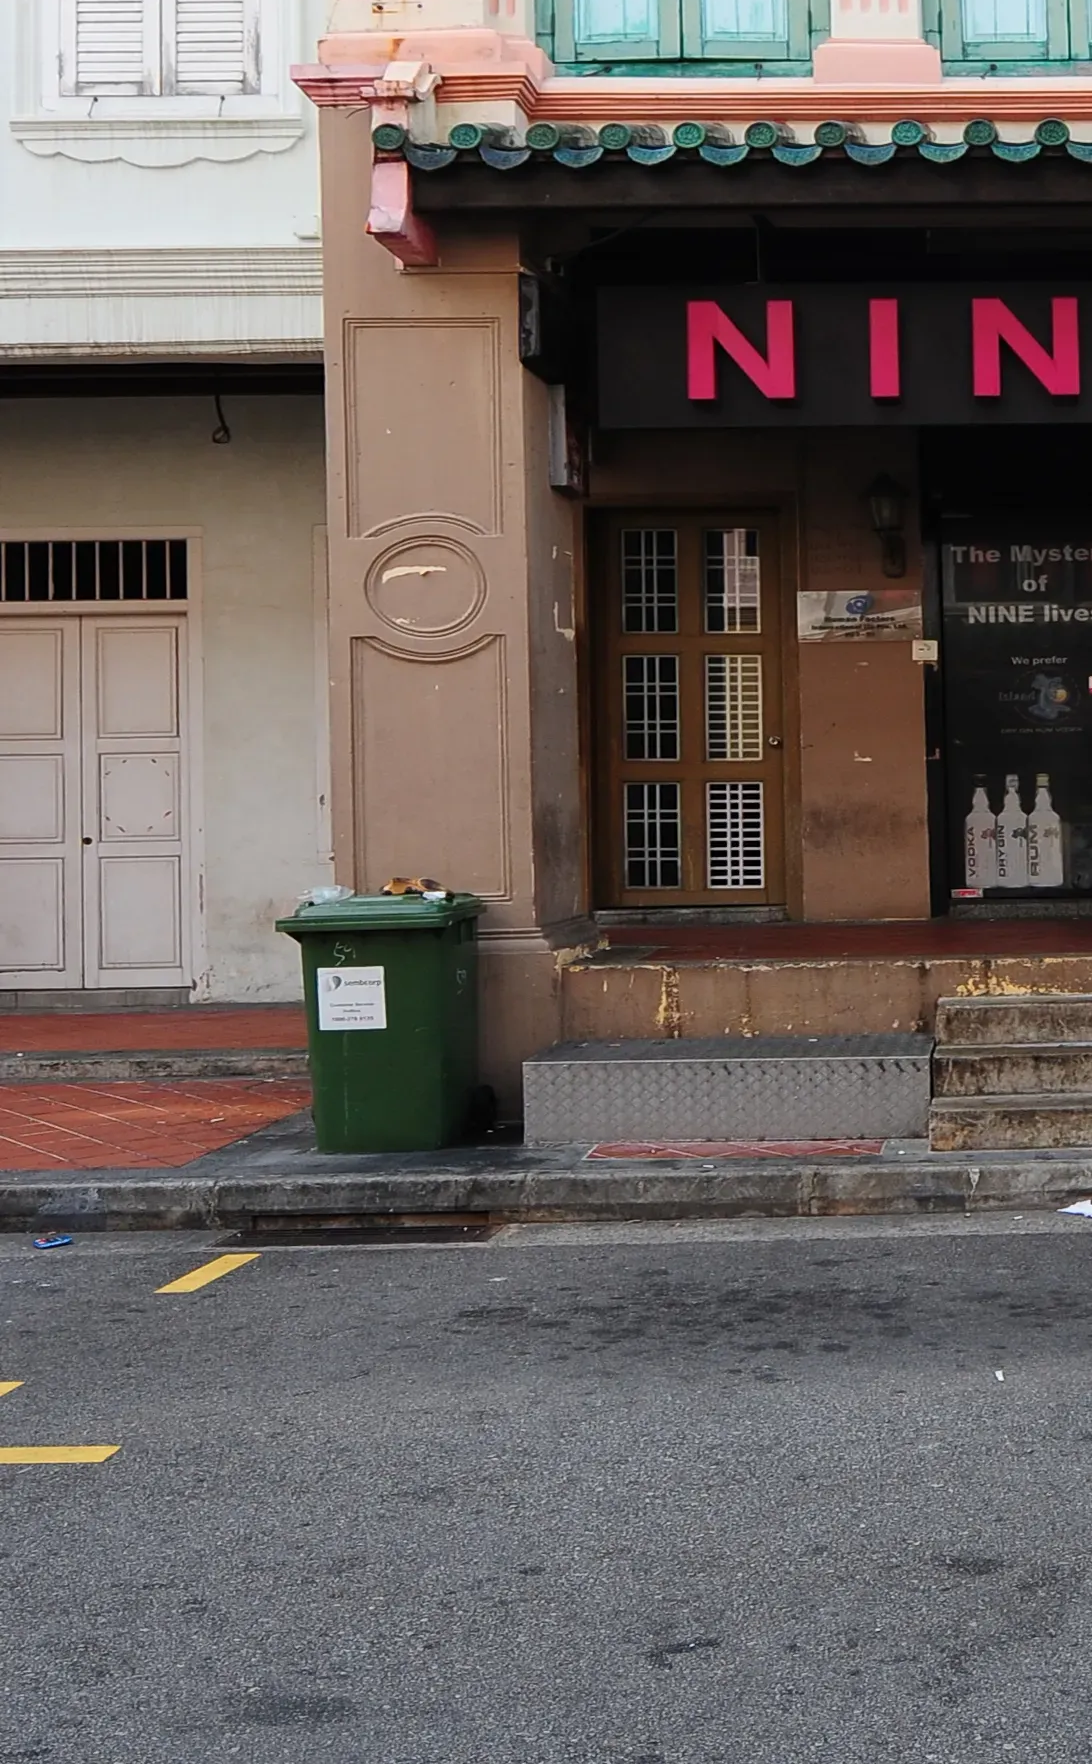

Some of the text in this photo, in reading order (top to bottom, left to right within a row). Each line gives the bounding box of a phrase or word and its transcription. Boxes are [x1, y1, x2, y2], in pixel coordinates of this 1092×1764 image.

[951, 545, 1001, 563] The
[1022, 574, 1048, 592] of
[967, 604, 1034, 624] NINE
[1010, 655, 1068, 667] We prefer
[967, 826, 976, 877] VODKA
[1029, 824, 1039, 877] RUM
